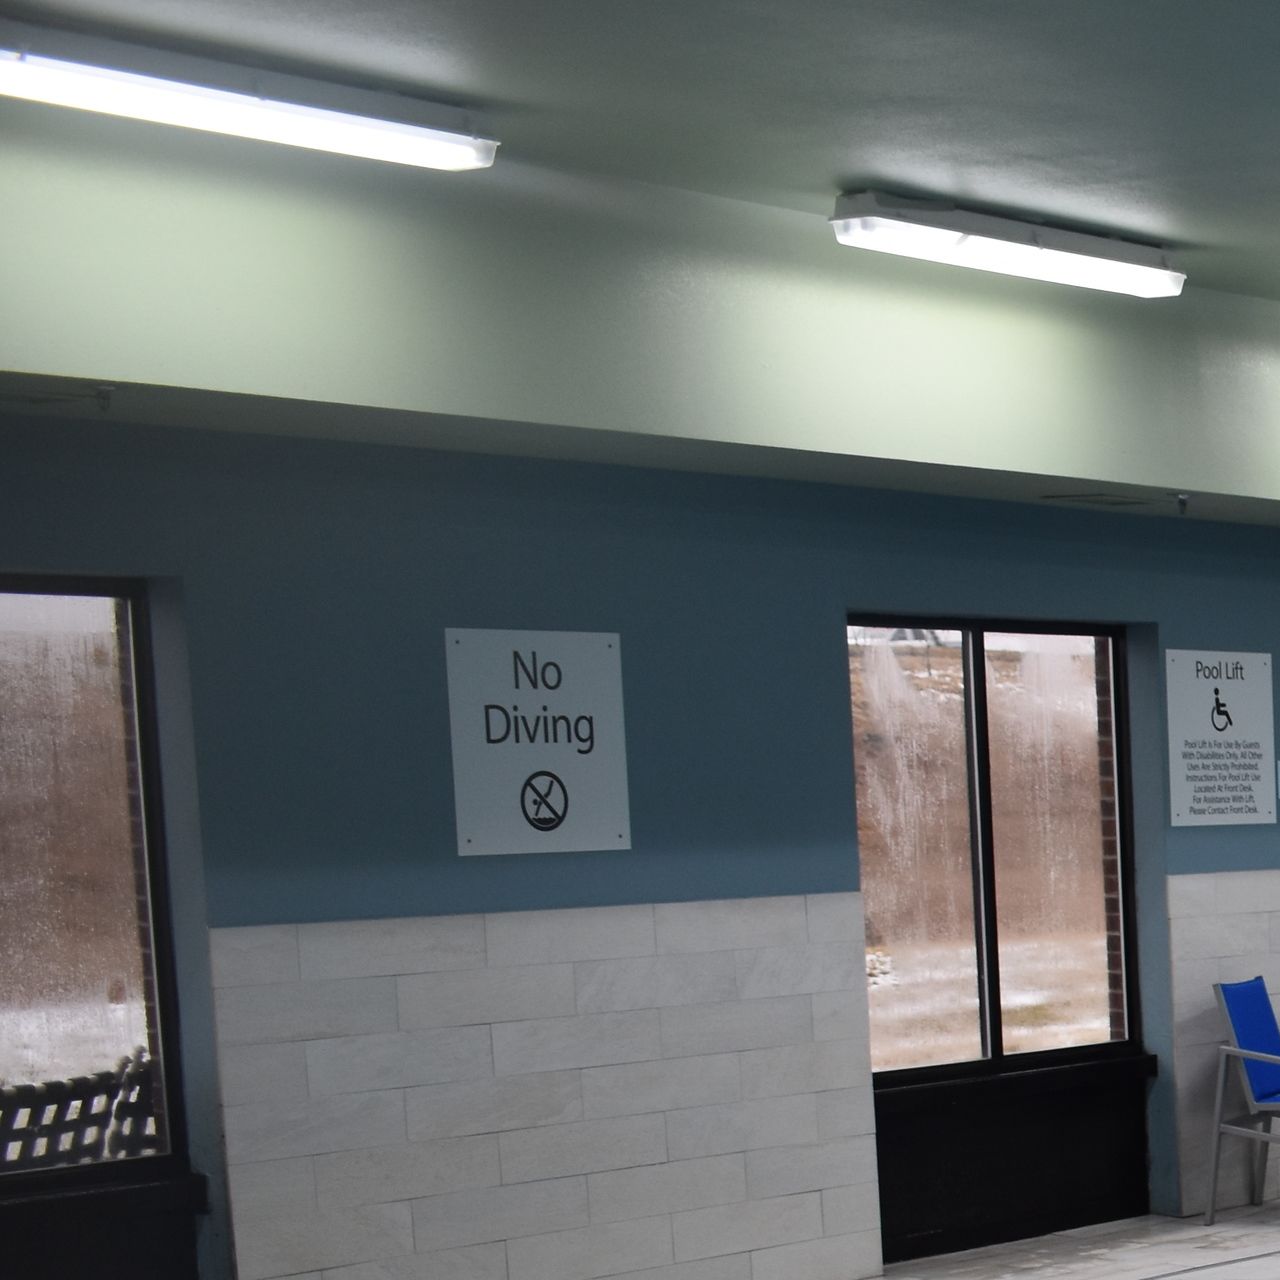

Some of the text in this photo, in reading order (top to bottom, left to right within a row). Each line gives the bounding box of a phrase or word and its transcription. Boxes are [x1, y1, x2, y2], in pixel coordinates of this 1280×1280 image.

[513, 650, 563, 690] No
[1196, 660, 1245, 680] Pool Lift
[483, 704, 595, 755] Diving
